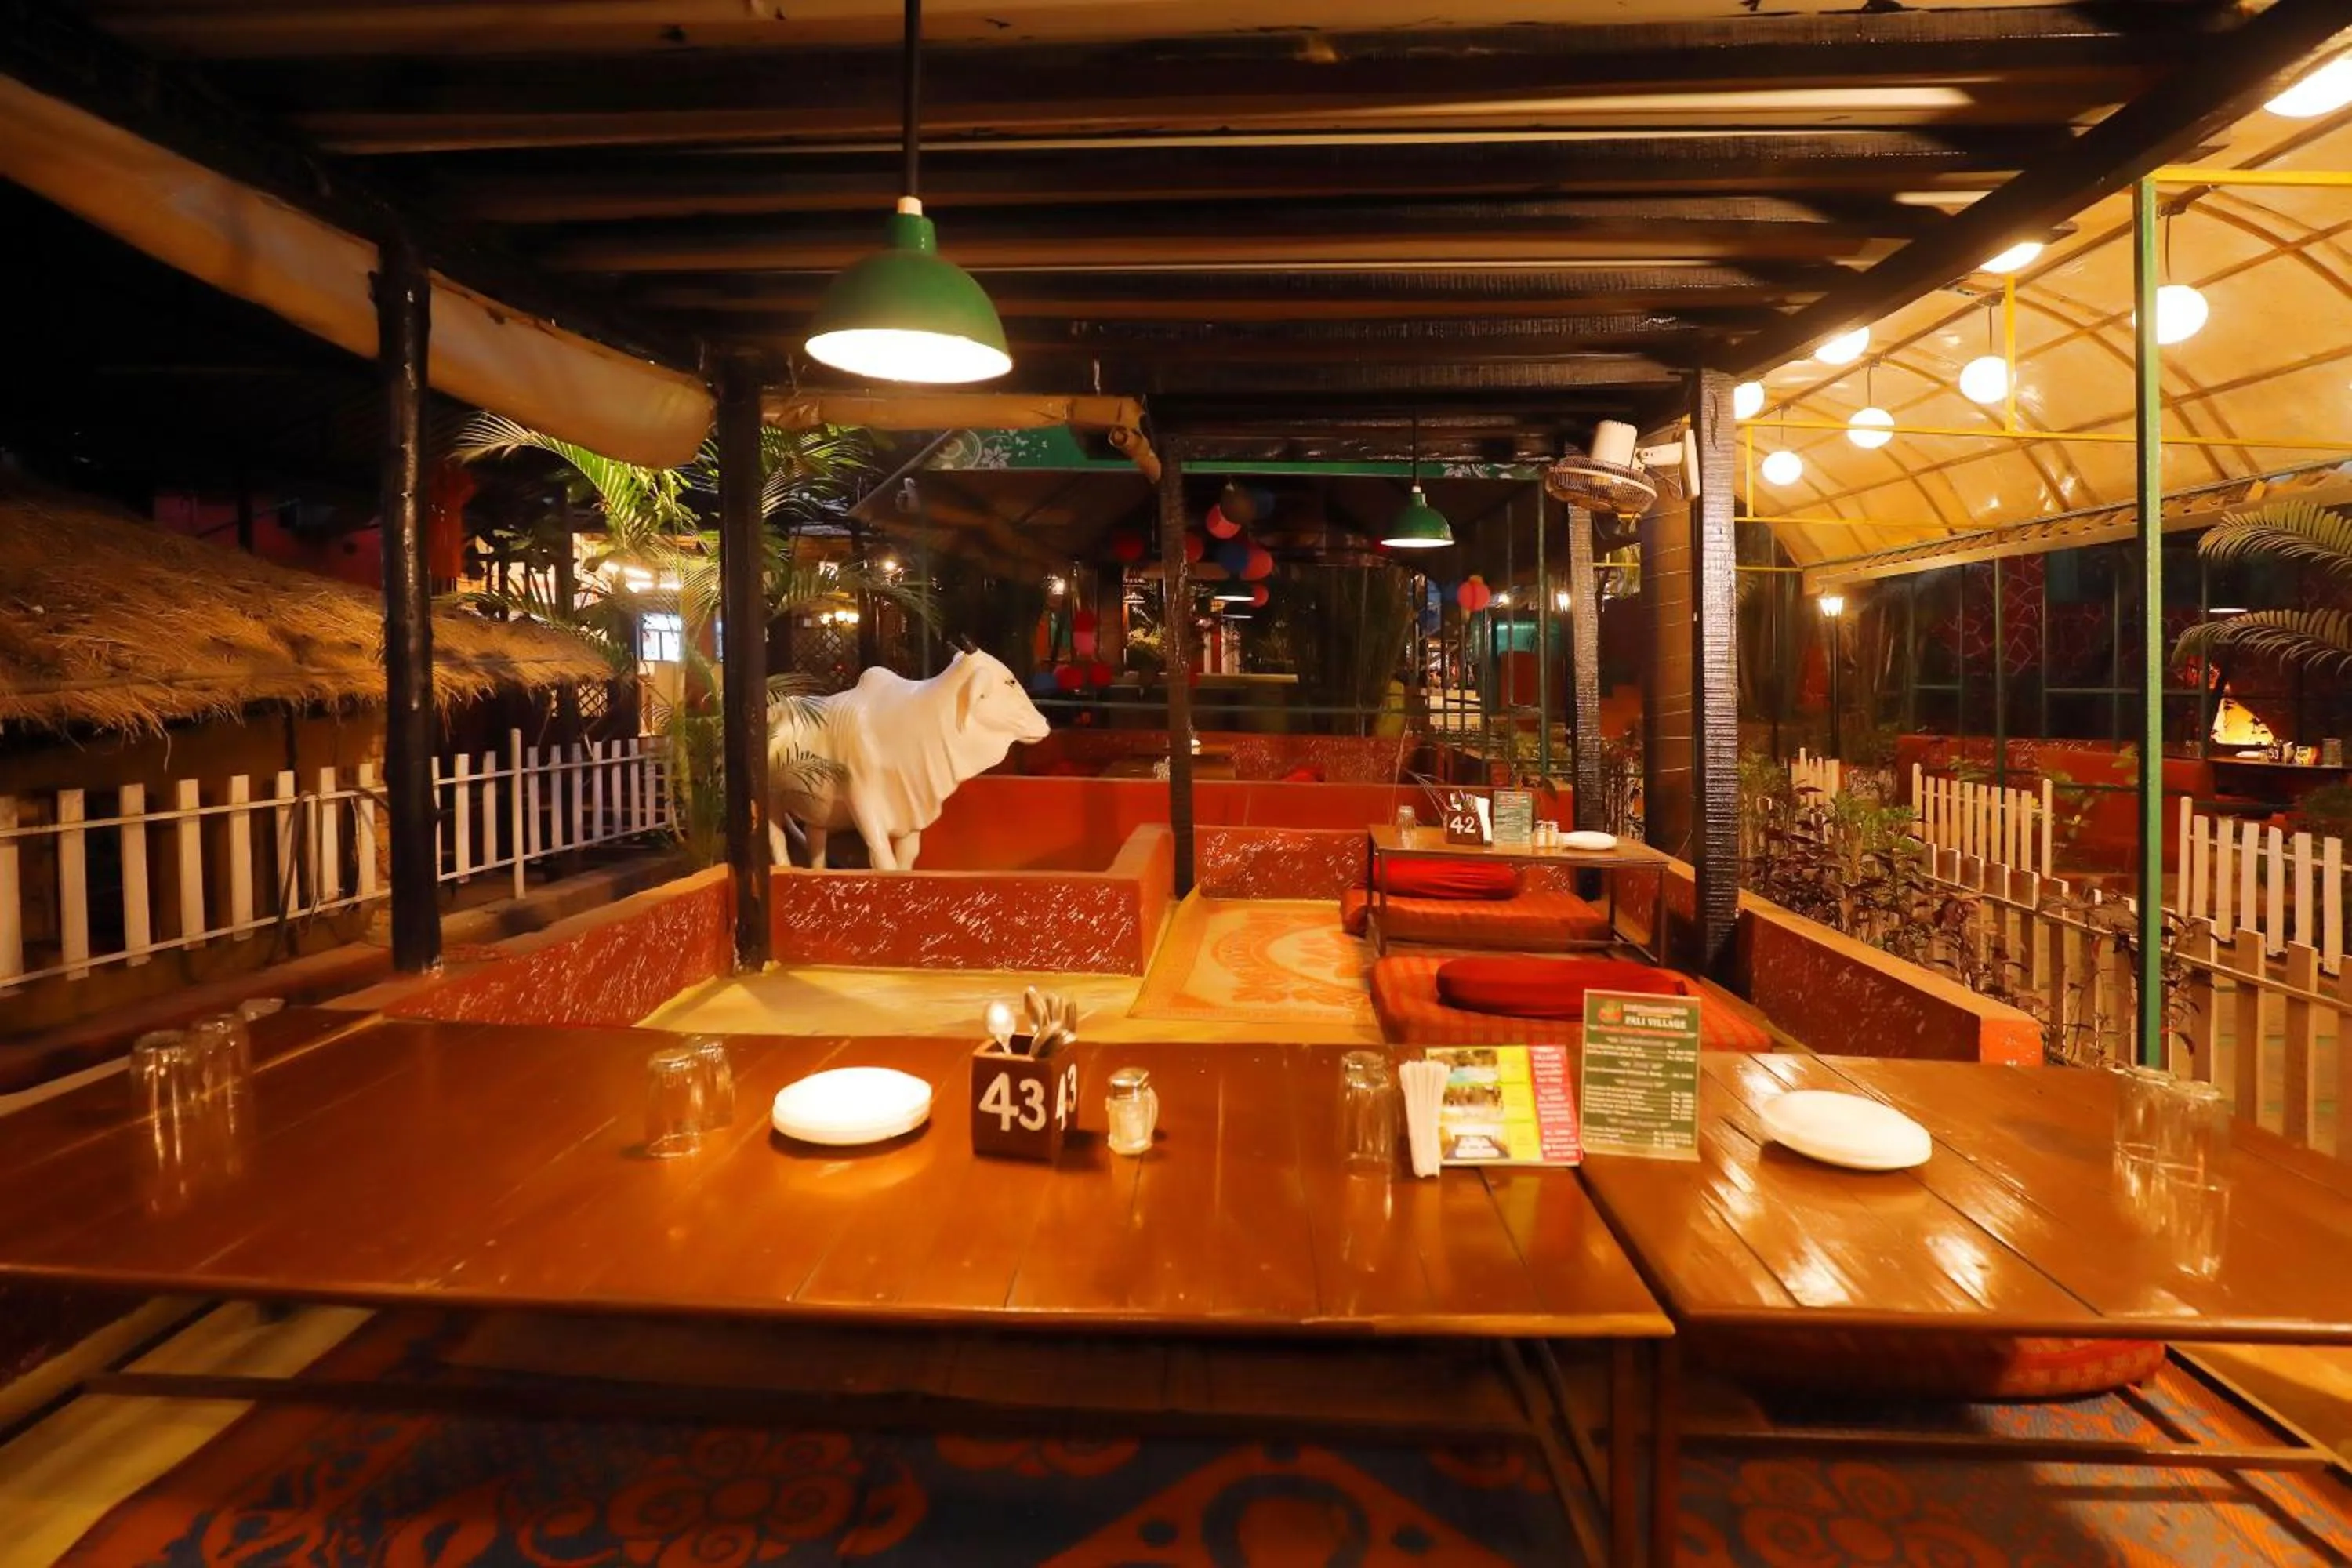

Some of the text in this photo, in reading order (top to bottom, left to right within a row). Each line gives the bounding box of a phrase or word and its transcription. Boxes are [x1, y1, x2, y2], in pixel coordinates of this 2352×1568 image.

[1450, 815, 1475, 834] 42
[1624, 1015, 1687, 1029] PALI VILLAGE
[978, 1072, 1047, 1132] 43
[1055, 1063, 1077, 1131] 43
